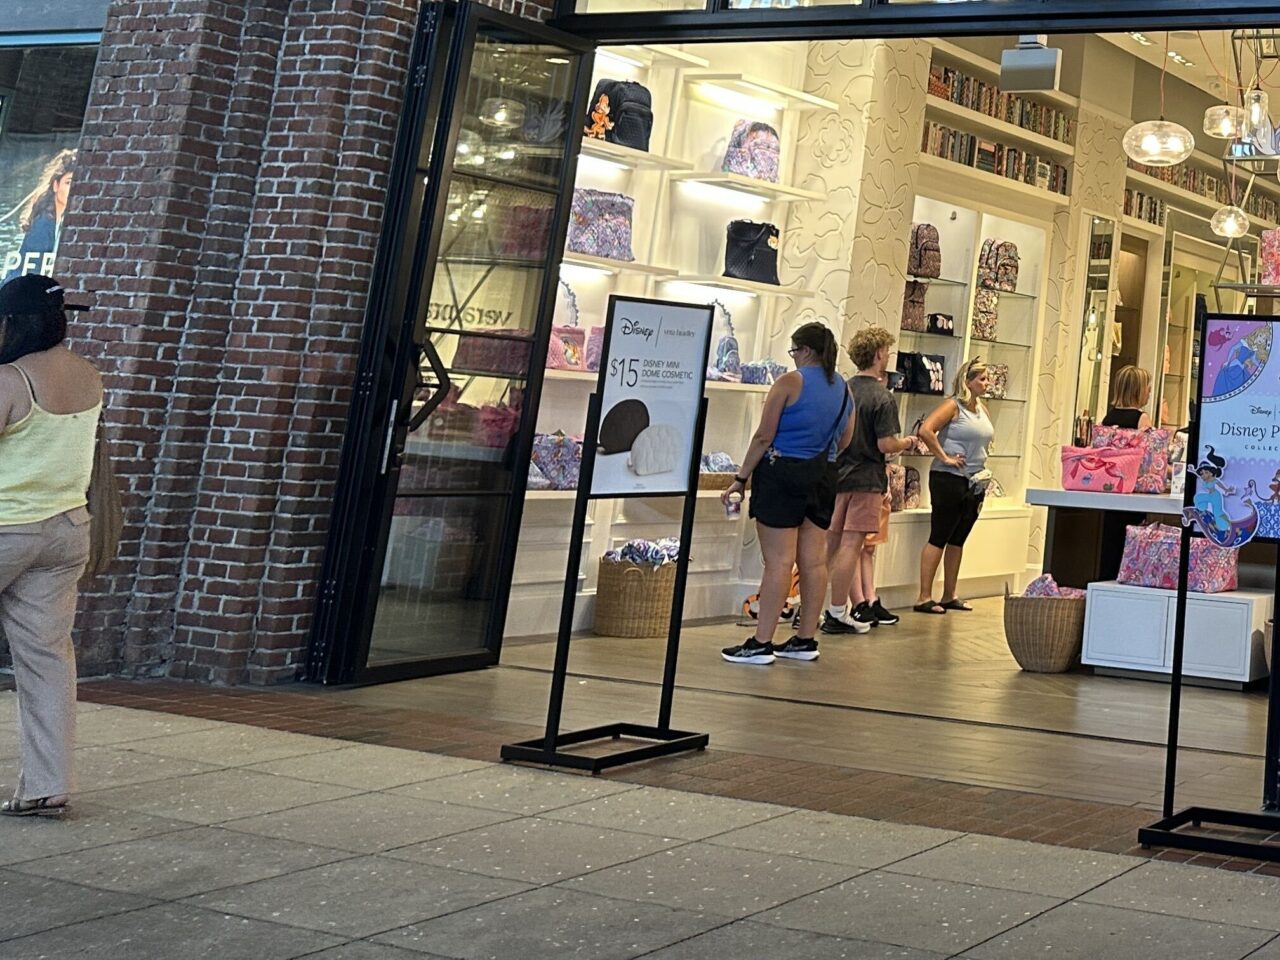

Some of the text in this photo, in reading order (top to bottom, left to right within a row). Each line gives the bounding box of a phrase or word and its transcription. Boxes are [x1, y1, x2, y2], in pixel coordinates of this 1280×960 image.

[620, 317, 654, 342] Disney
[610, 358, 640, 387] $15
[642, 359, 680, 369] DISNEY MINI
[641, 369, 694, 380] DOME COSMETIC
[1220, 422, 1267, 442] Disney
